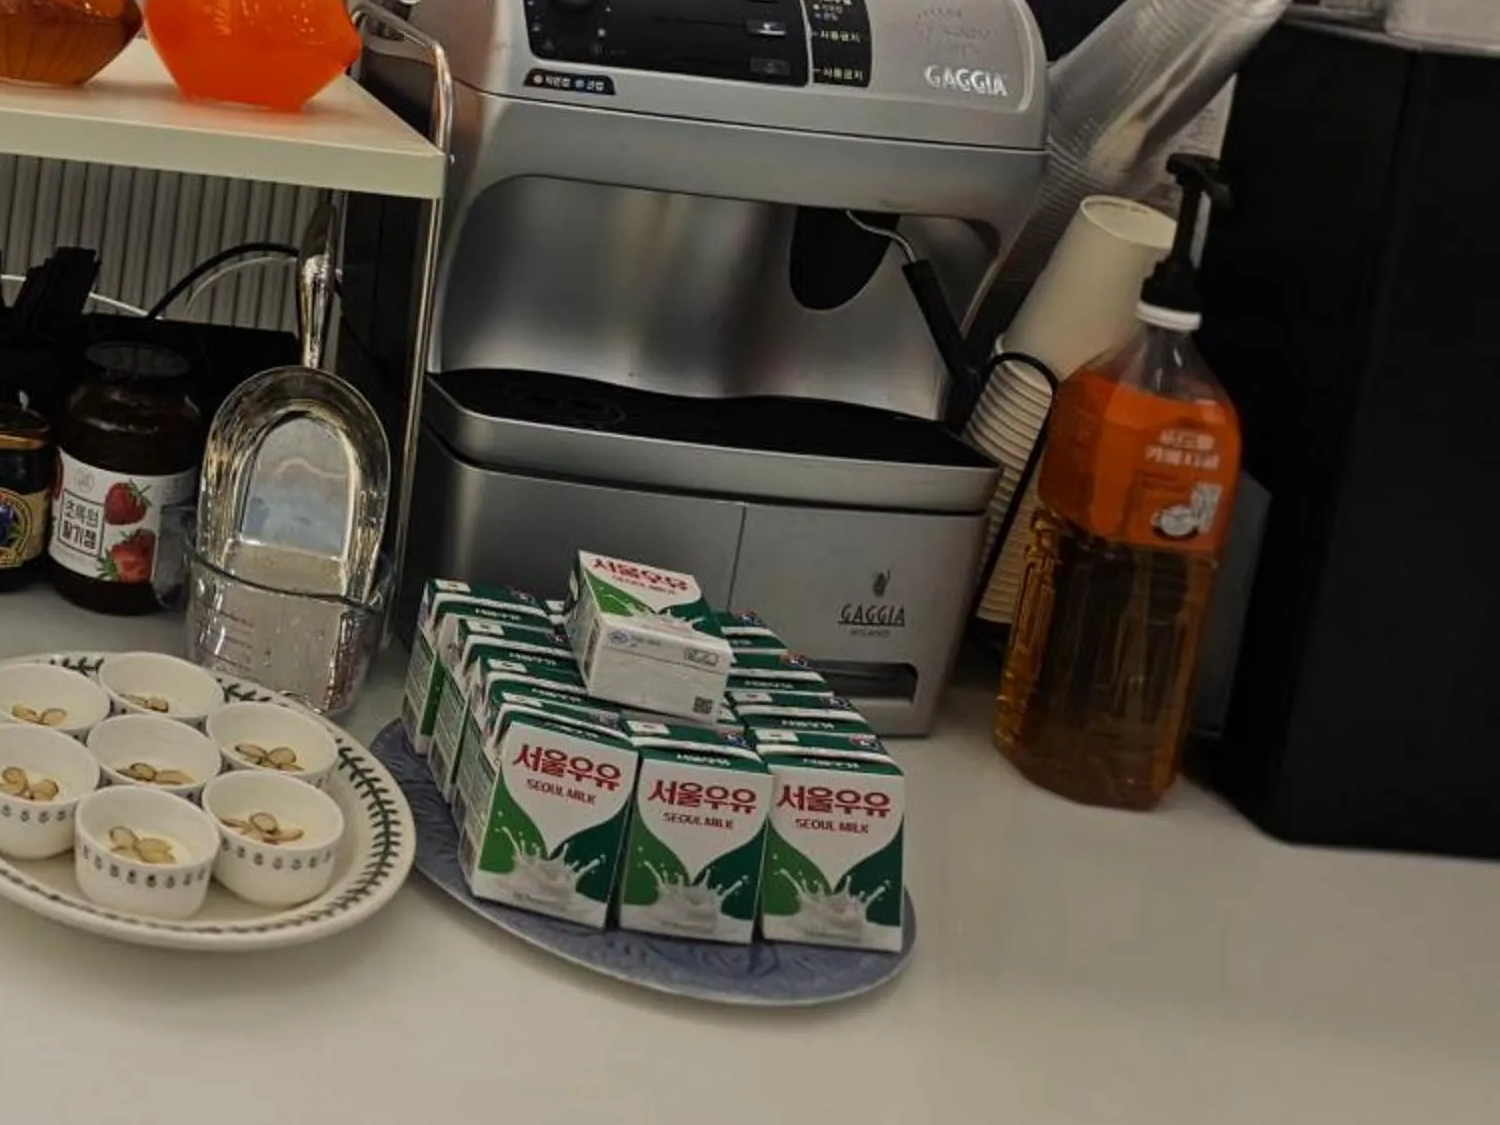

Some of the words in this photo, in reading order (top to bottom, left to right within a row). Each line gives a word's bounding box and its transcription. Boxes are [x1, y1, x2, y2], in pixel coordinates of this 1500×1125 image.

[924, 64, 1008, 97] GAGGIA
[63, 520, 97, 550] 딸기잼
[592, 557, 689, 592] 서울우유
[840, 602, 905, 627] GAGGIA
[512, 744, 621, 791] 서울우유
[527, 778, 565, 797] SEOUL
[566, 787, 596, 805] MILK
[648, 778, 757, 814] 서울우유
[776, 784, 891, 817] 서울우유
[661, 813, 703, 827] SEOUL
[704, 816, 734, 830] MILK
[794, 818, 835, 832] SEOUL
[838, 820, 869, 834] MILK
